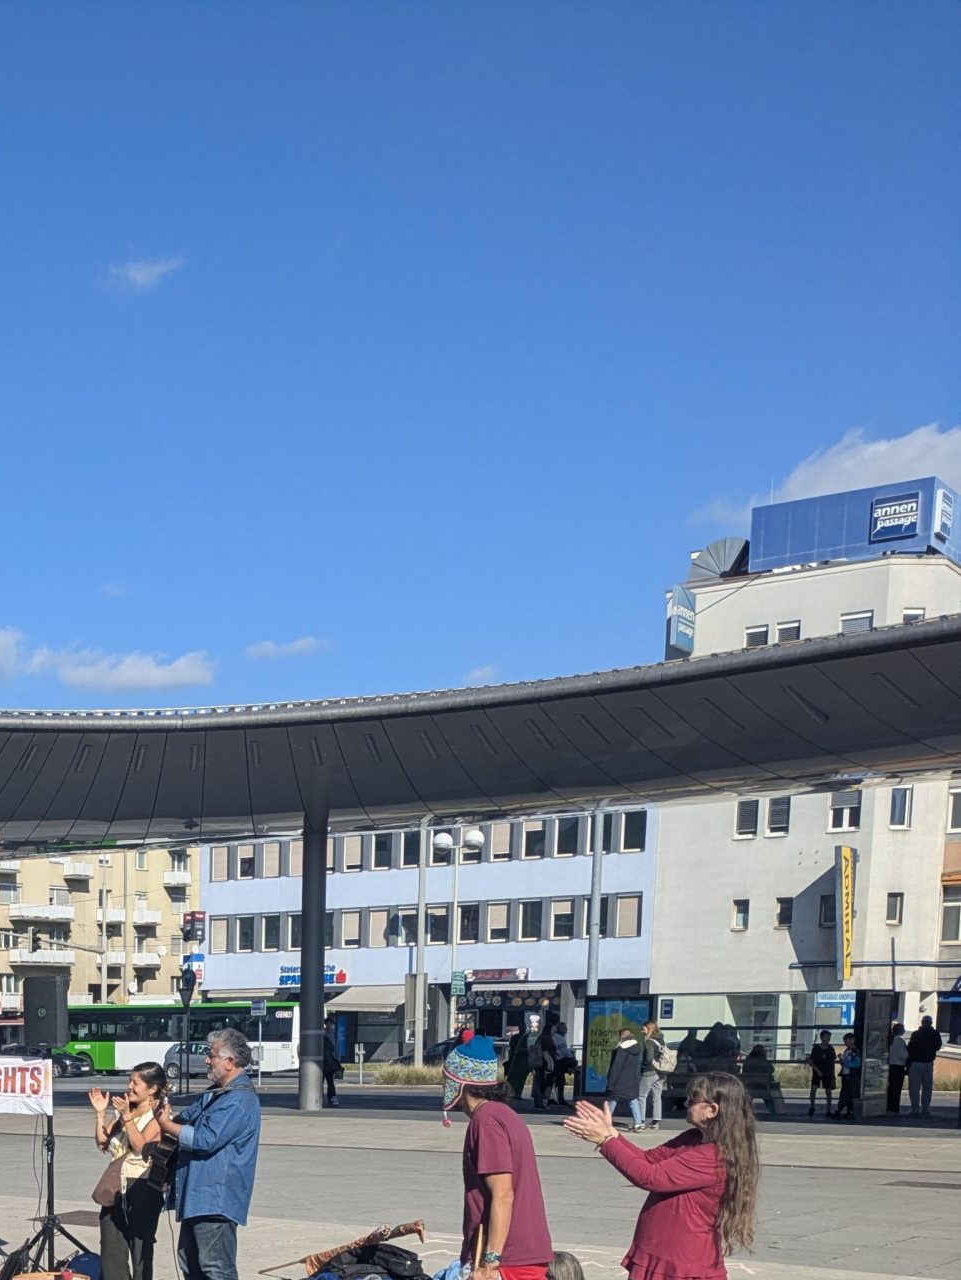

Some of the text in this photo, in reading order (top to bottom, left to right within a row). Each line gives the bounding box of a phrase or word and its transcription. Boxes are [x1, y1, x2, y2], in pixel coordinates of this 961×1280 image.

[874, 502, 917, 517] annen
[874, 515, 917, 531] passage
[843, 855, 851, 968] ADMIRAL
[590, 1028, 619, 1037] Nächs
